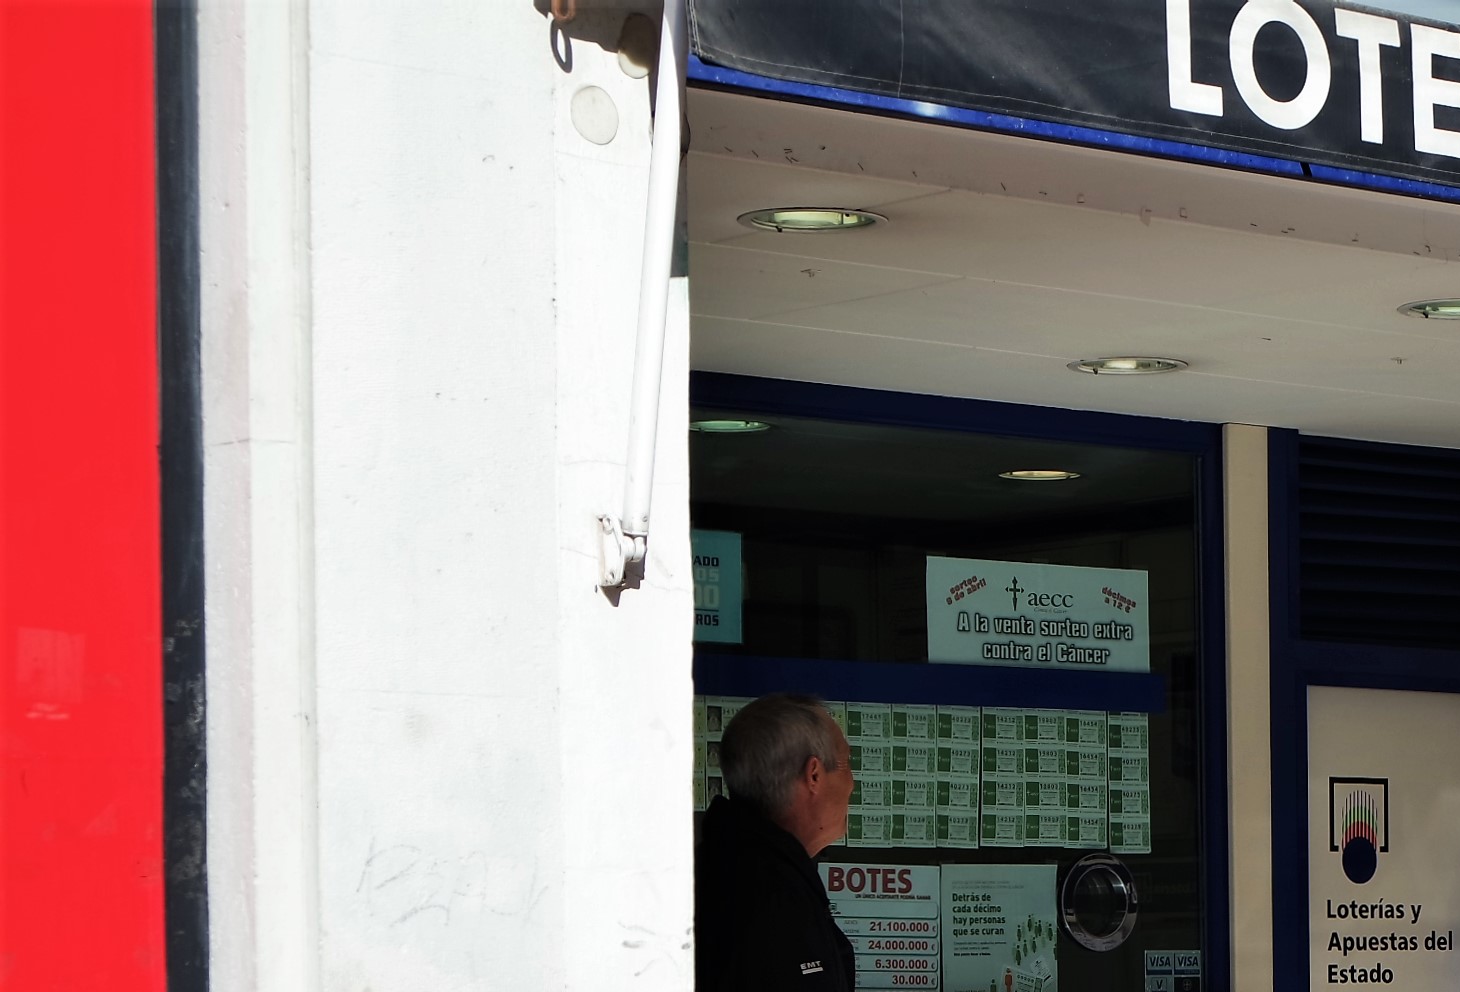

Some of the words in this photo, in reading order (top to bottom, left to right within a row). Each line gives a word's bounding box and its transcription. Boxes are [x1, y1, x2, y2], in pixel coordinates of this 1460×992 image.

[693, 555, 720, 568] ADO
[1028, 592, 1074, 608] aecc
[695, 613, 720, 627] ROS
[957, 612, 970, 632] A
[975, 613, 990, 633] la
[995, 616, 1035, 636] venta
[1040, 619, 1089, 639] sorteo
[1093, 621, 1134, 641] extra
[983, 641, 1033, 661] contra
[1037, 644, 1051, 662] el
[1056, 644, 1111, 665] Cáncer
[829, 867, 913, 894] BOTES
[952, 892, 980, 902] Detrás
[981, 893, 992, 902] de
[953, 904, 972, 913] cada
[973, 903, 1002, 913] décimo
[1327, 898, 1405, 919] Loterías
[1411, 903, 1422, 924] y
[869, 921, 930, 932] 21.100.000
[953, 916, 967, 926] hay
[969, 917, 1006, 926] personas
[953, 928, 968, 938] que
[982, 928, 1005, 936] curan
[868, 940, 929, 951] 24.000.000
[1328, 932, 1419, 956] Apuestas
[1424, 931, 1454, 951] del
[800, 961, 821, 970] EMT
[875, 959, 929, 970] 6.300.000
[1150, 956, 1171, 967] VISA
[1178, 956, 1199, 967] VISA
[1328, 963, 1394, 984] Estado
[892, 975, 929, 985] 30.000
[1156, 980, 1163, 990] V
